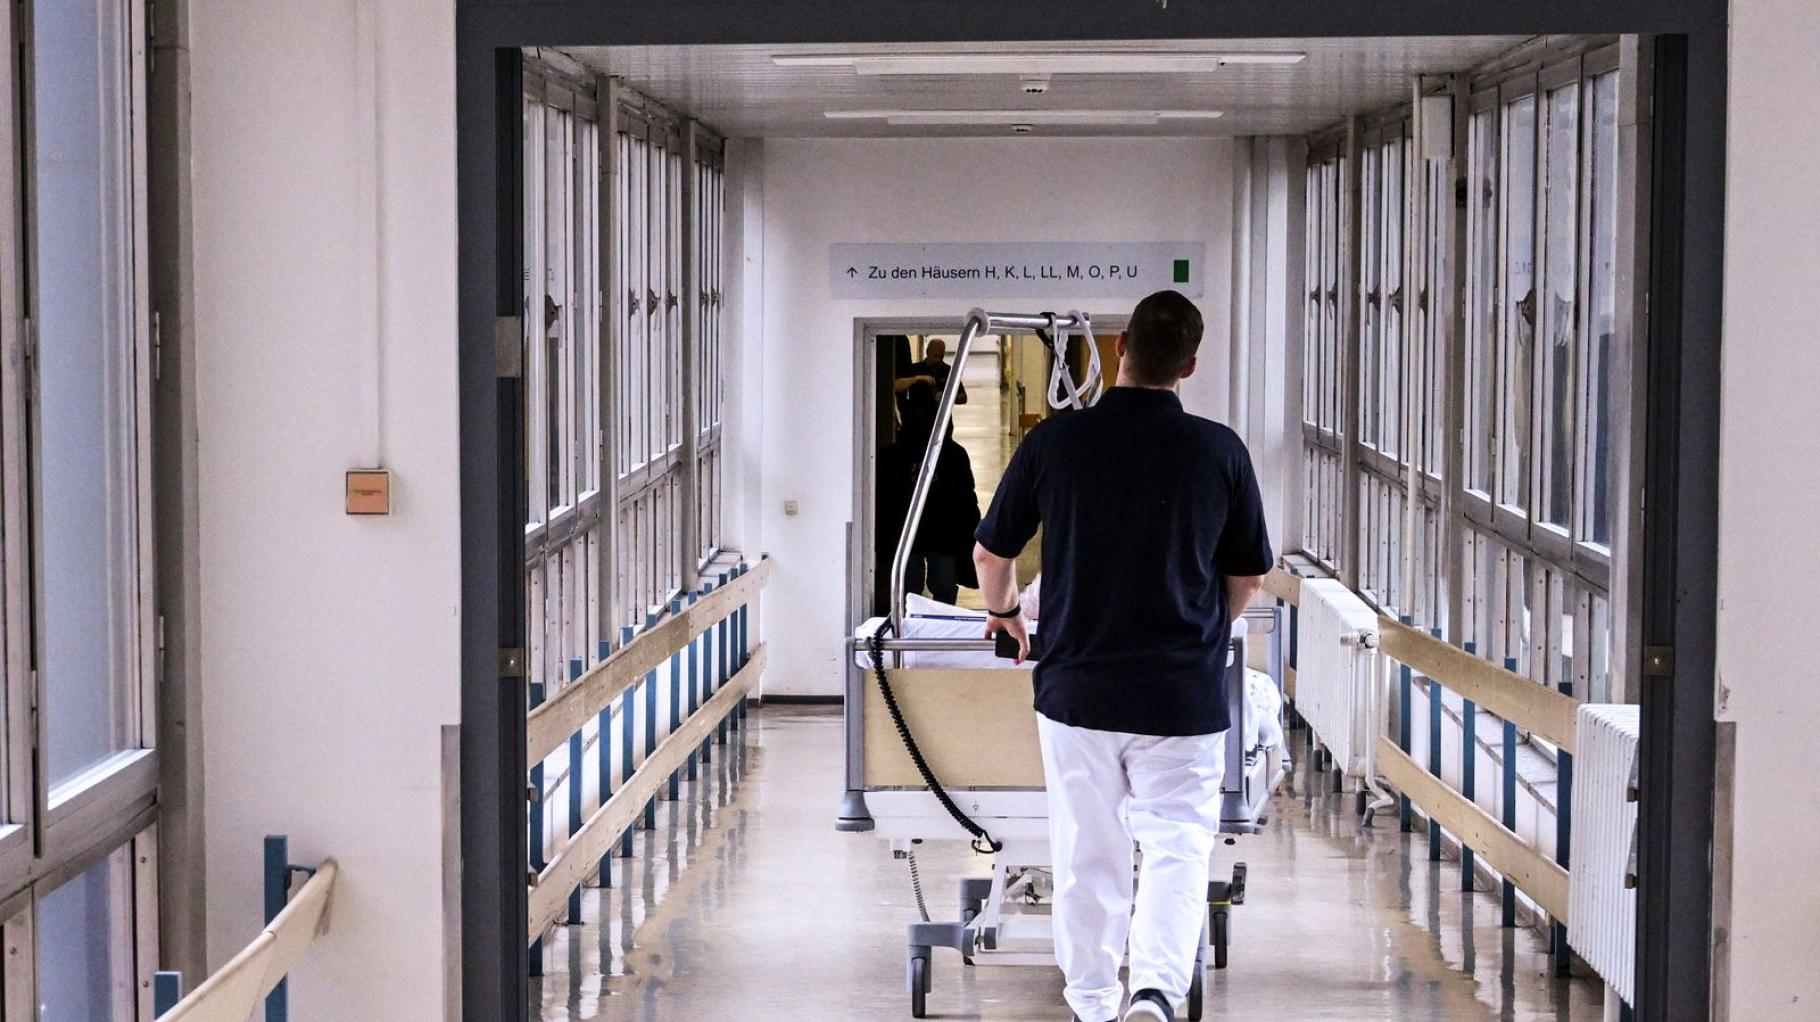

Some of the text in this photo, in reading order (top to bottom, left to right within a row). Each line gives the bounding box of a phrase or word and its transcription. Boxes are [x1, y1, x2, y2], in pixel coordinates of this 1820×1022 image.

[869, 264, 1138, 281] Zu den Häusern H, K, L, LL, M, O, P, U
